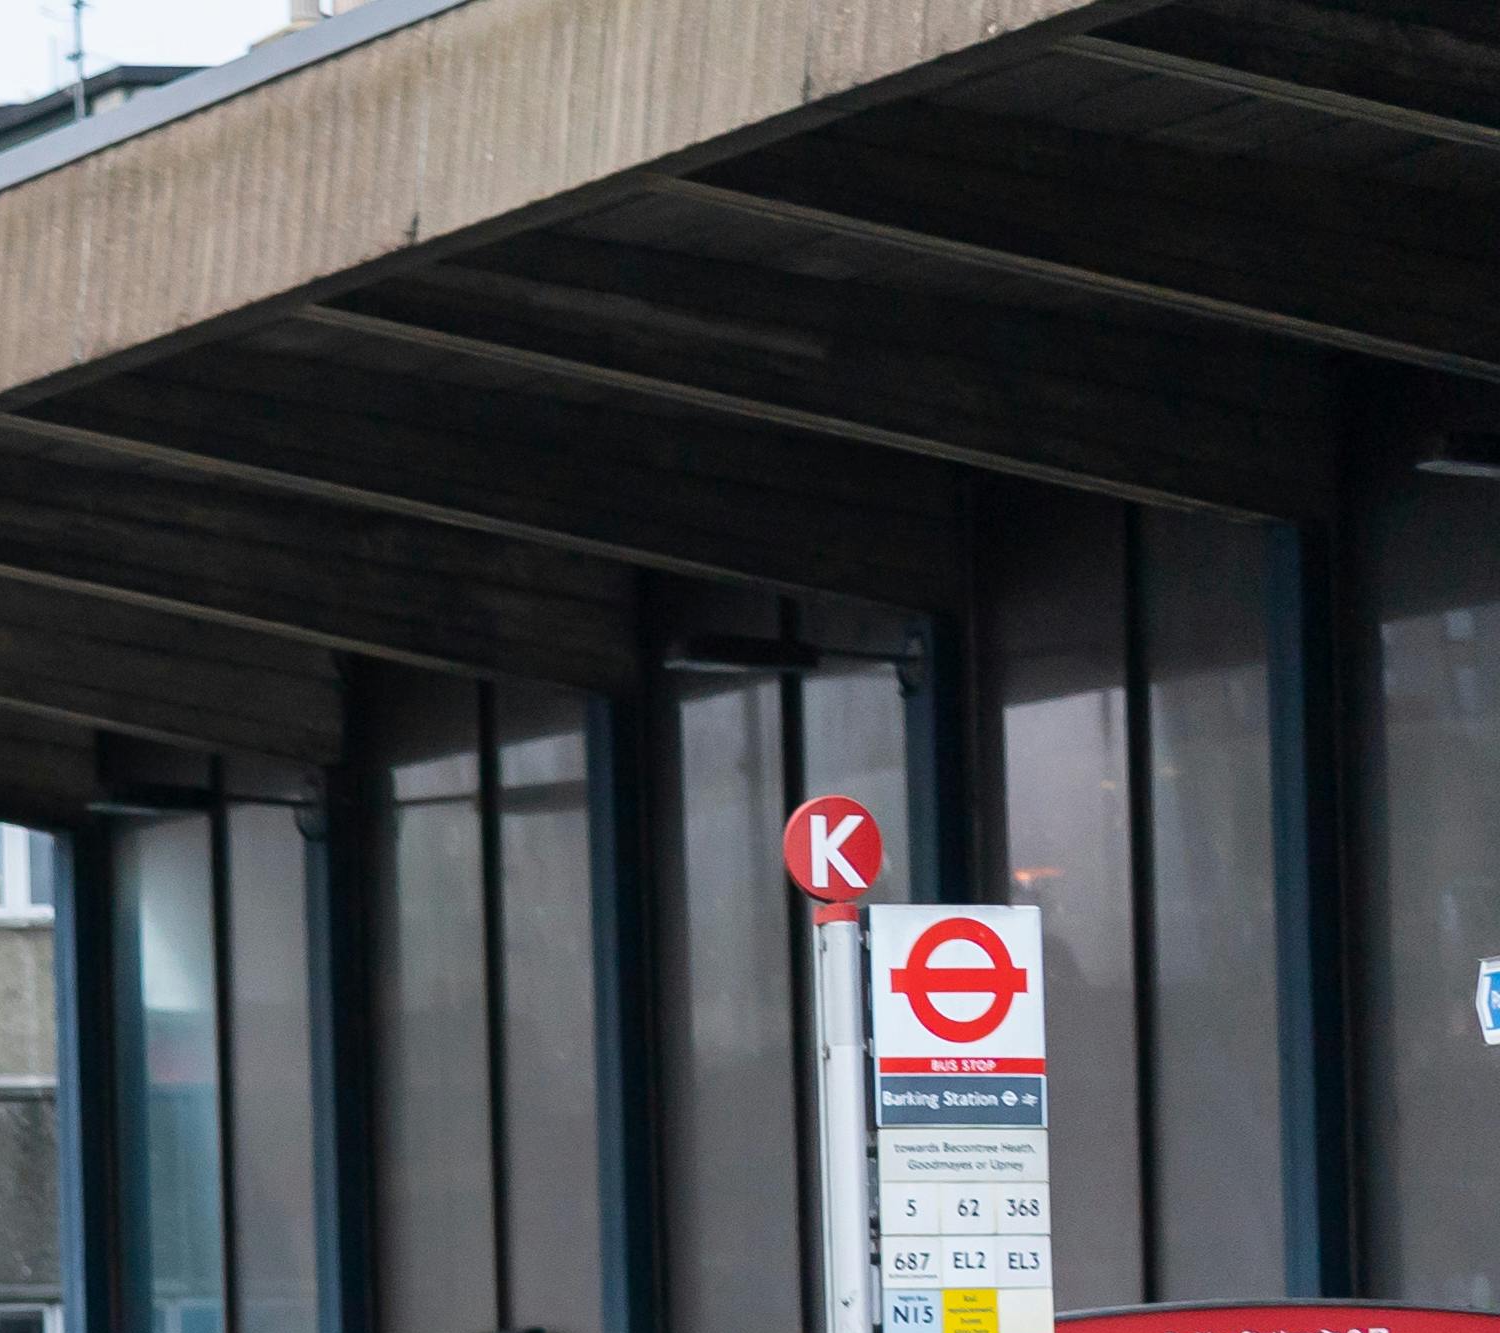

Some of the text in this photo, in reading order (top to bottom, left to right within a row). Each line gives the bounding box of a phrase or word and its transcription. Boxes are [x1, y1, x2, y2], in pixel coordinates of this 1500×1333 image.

[809, 814, 867, 889] K
[931, 1060, 996, 1072] BUS STOP
[882, 1091, 998, 1110] Barking Station
[894, 1142, 940, 1153] towards
[905, 1199, 1040, 1217] 5 62 368
[894, 1251, 1040, 1271] 687 EL2 EL3
[893, 1305, 934, 1324] N15
